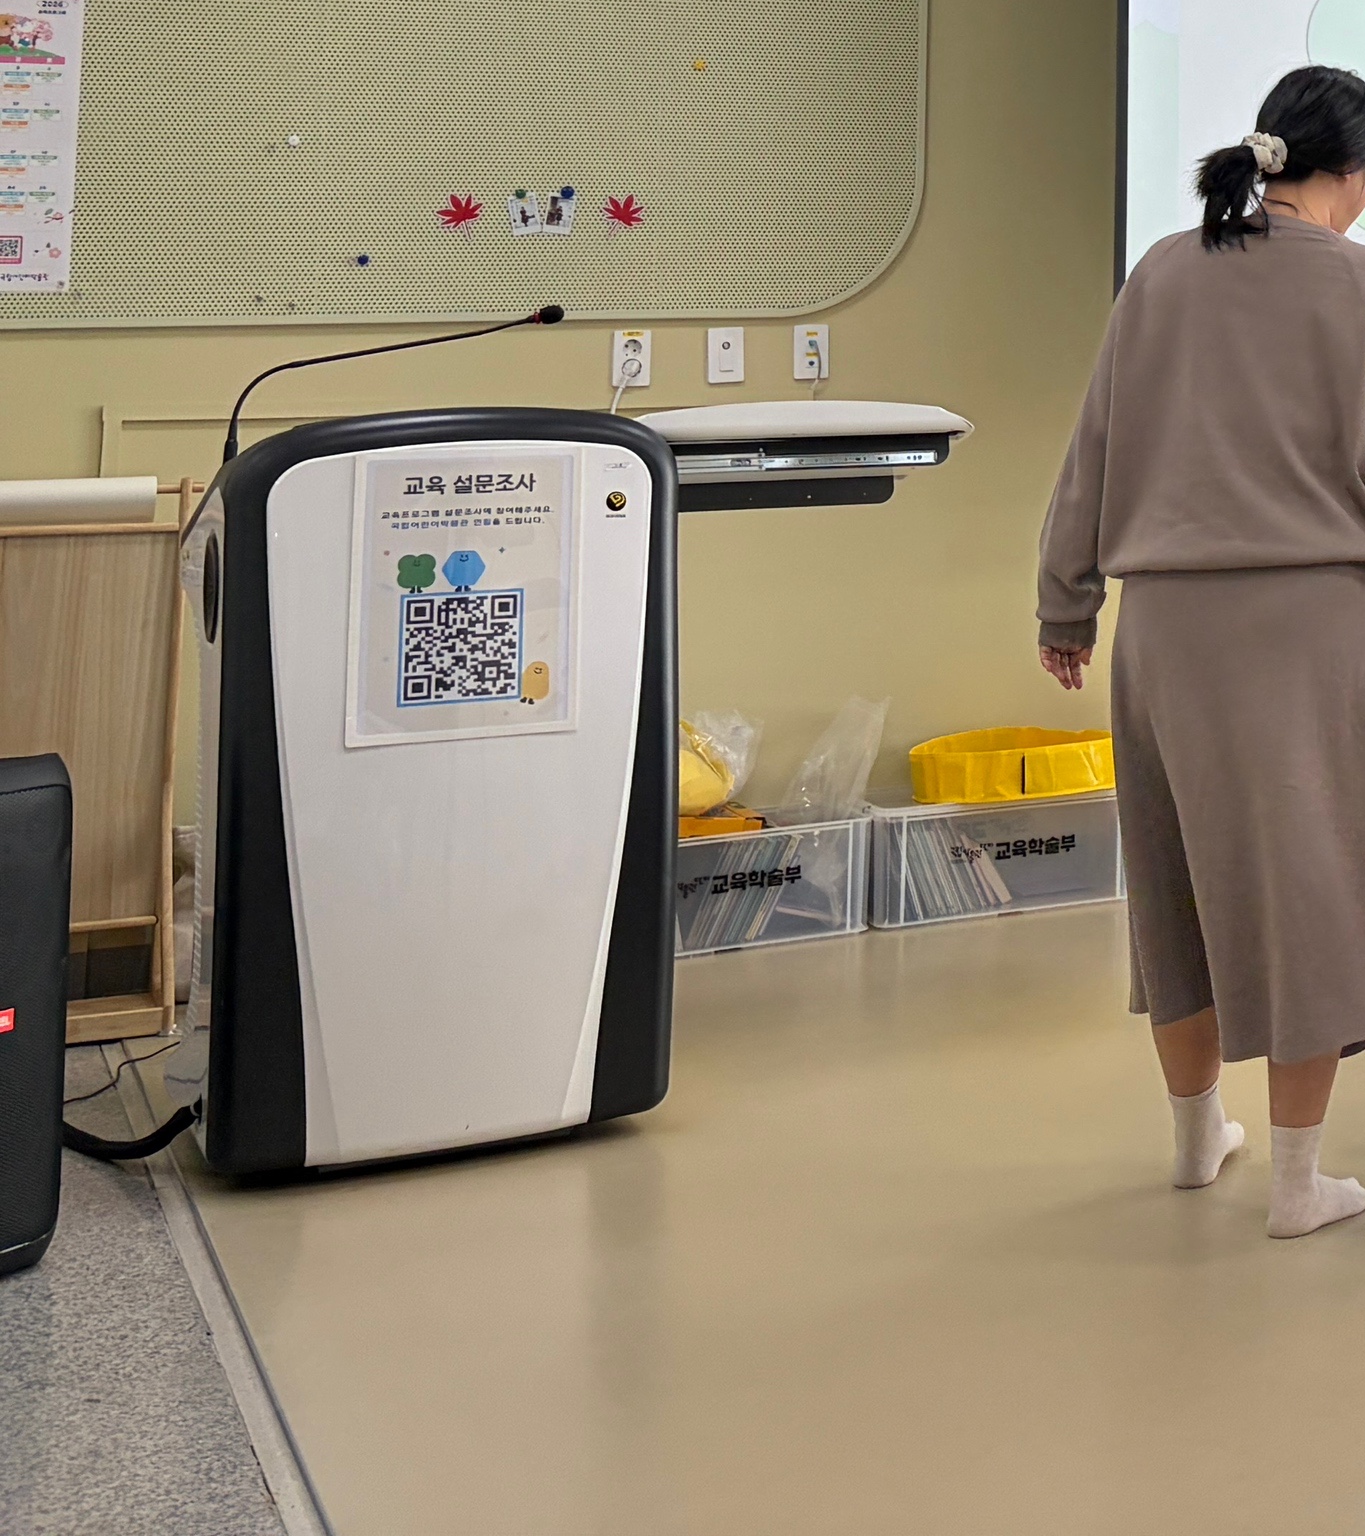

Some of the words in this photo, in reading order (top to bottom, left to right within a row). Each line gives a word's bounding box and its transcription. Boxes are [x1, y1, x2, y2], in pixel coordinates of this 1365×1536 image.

[403, 475, 446, 495] 교육
[453, 472, 537, 494] 설문조사
[994, 834, 1077, 861] 교육학술부
[711, 865, 801, 894] 교육학술부
